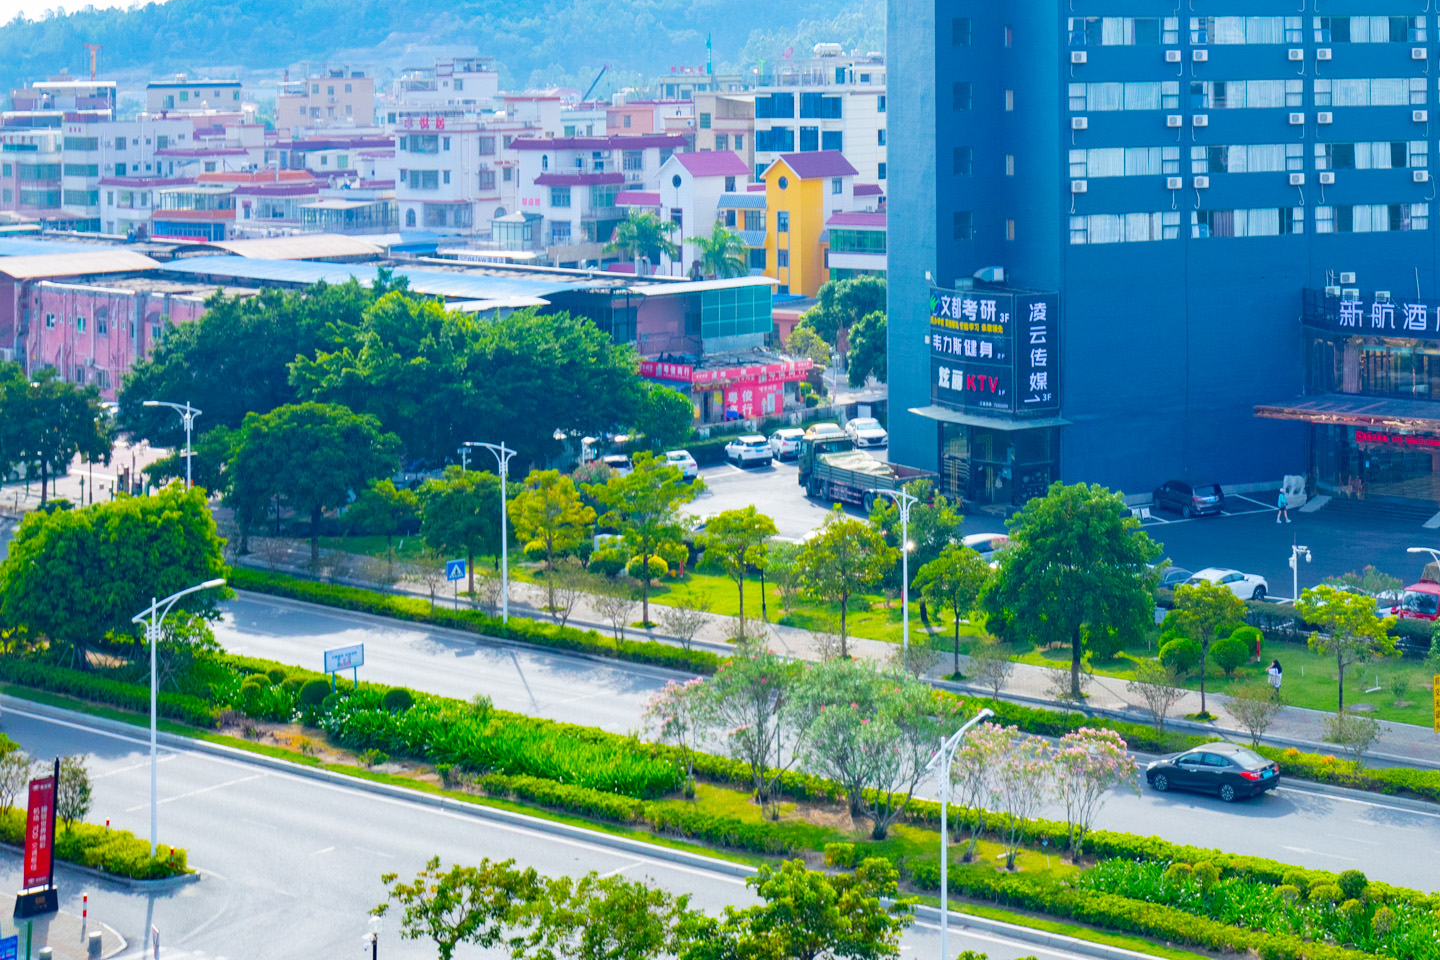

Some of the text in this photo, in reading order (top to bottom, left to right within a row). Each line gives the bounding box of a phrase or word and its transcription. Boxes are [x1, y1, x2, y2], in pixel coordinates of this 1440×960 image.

[941, 295, 996, 321] 文都考研
[999, 313, 1010, 323] 3F
[933, 334, 992, 358] 韦力斯健身
[1029, 302, 1047, 391] 凌云传媒
[966, 374, 998, 393] KTV
[1042, 393, 1052, 402] 3F
